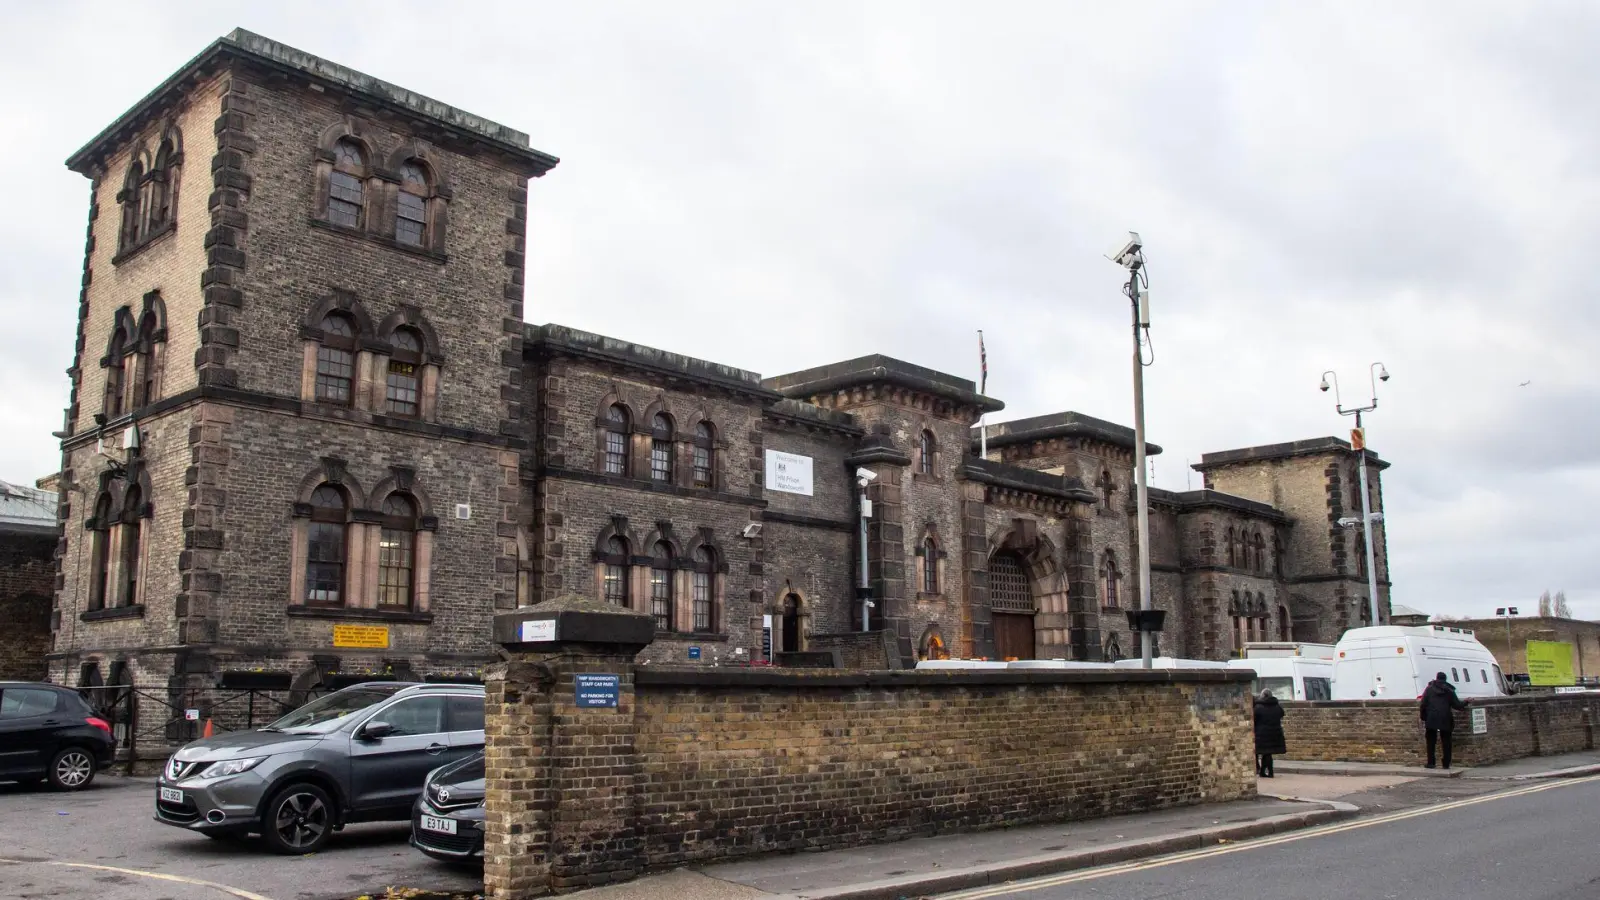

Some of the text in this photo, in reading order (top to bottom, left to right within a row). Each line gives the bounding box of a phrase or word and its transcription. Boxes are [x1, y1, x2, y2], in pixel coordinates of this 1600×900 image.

[786, 475, 800, 483] Prison
[427, 817, 450, 831] E3 TAJ
